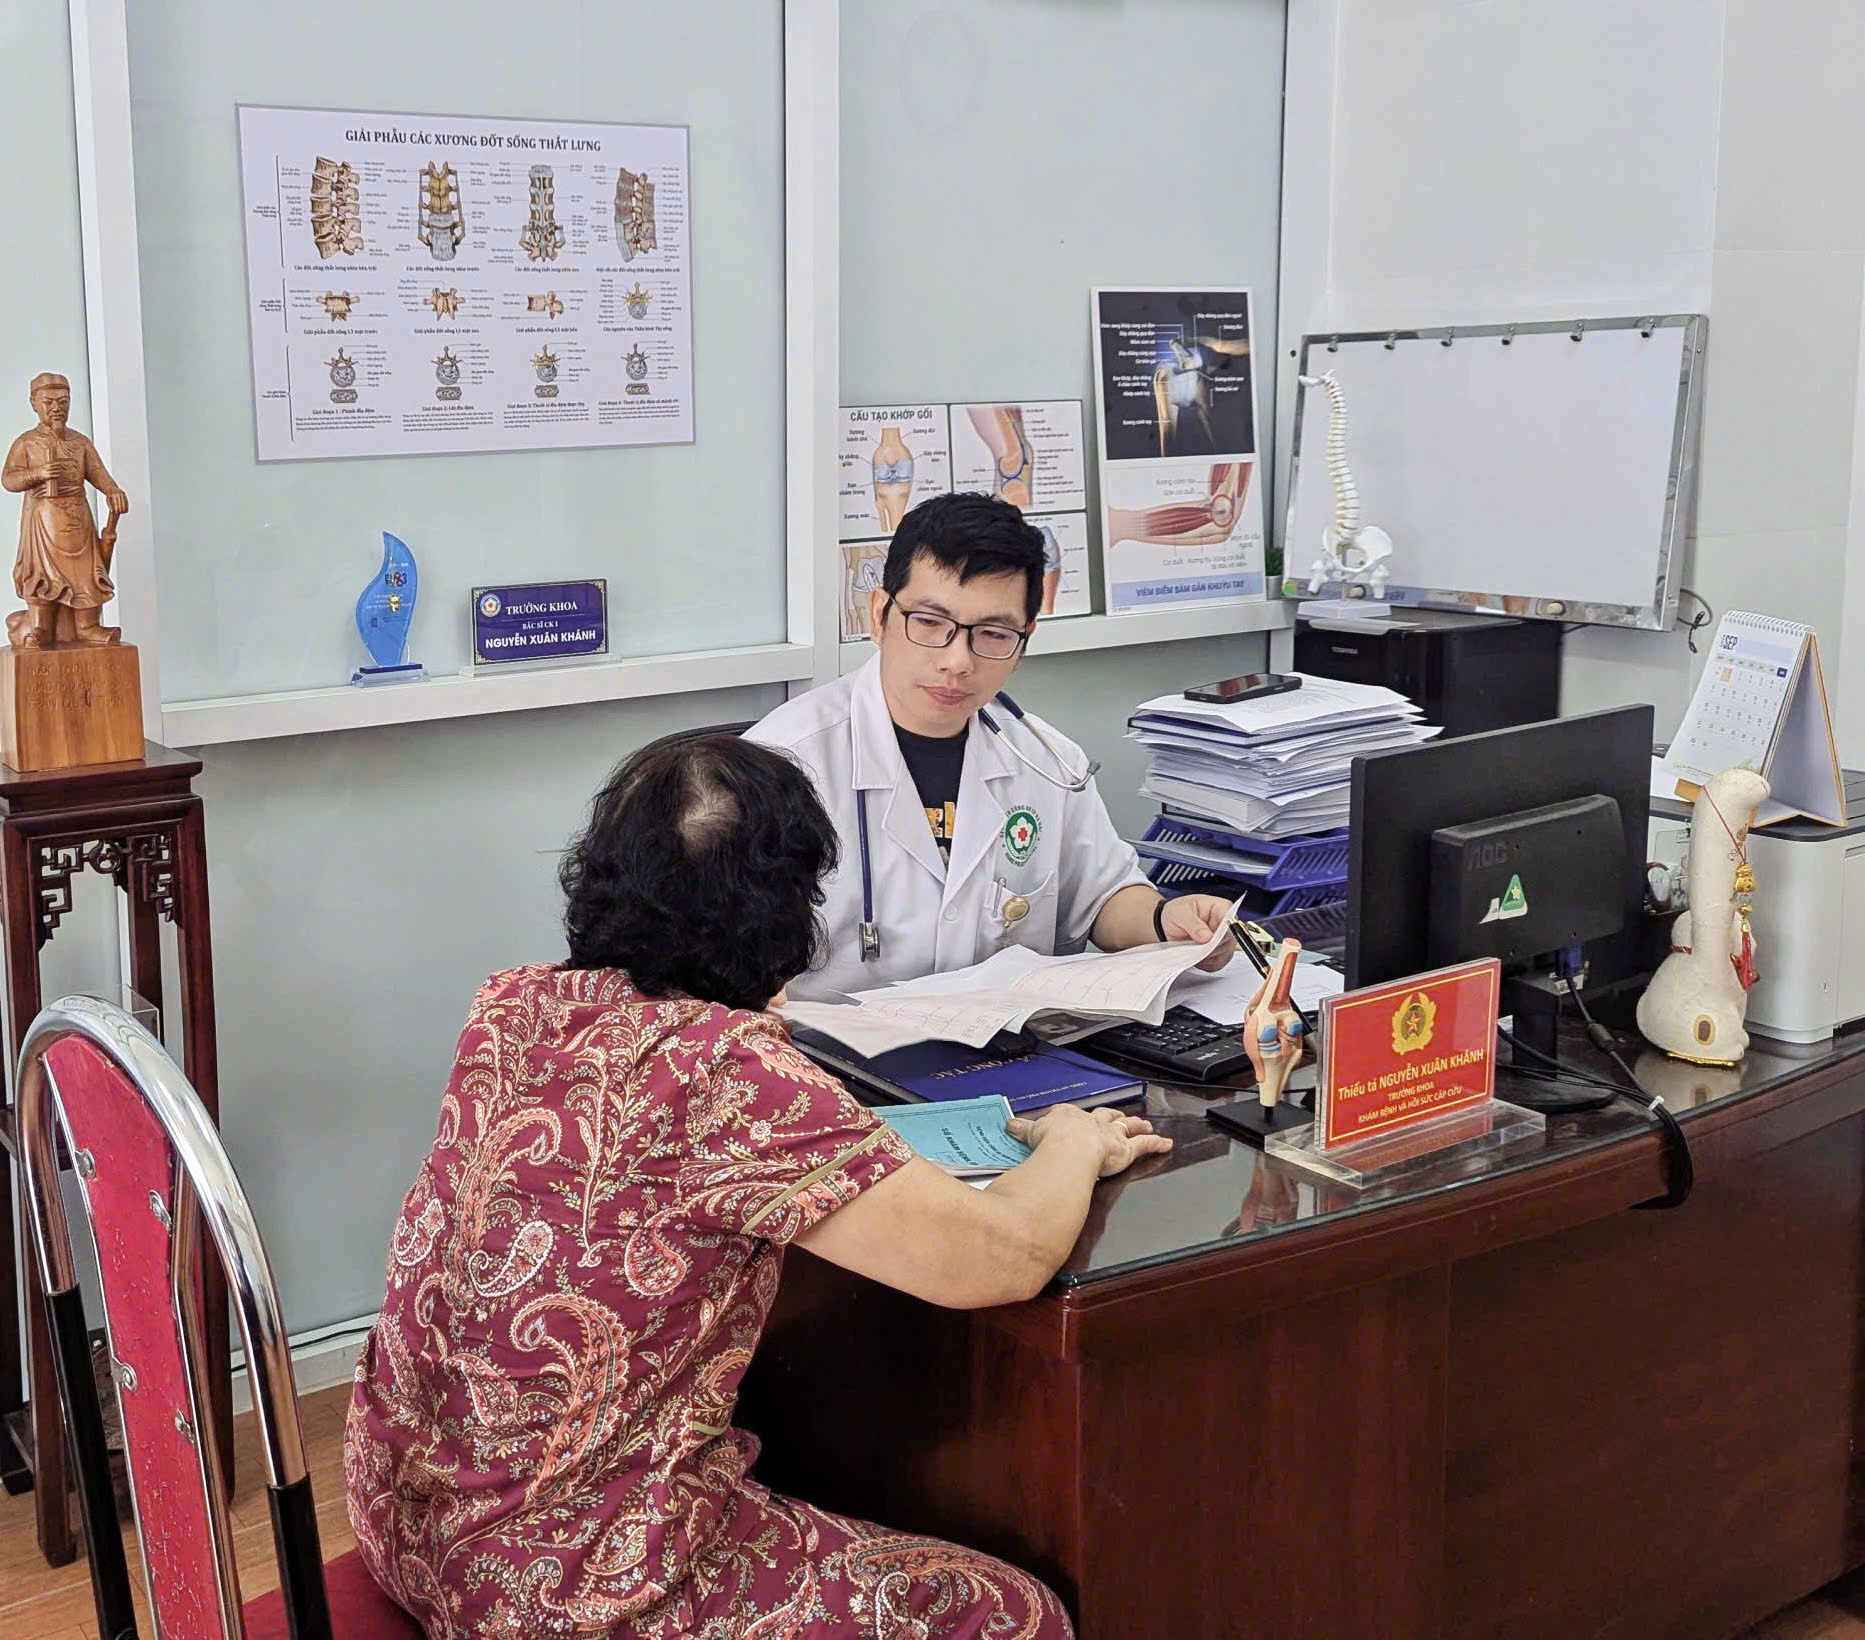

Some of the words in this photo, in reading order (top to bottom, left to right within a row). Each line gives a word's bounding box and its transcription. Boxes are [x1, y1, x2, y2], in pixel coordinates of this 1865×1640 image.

[346, 128, 371, 142] GIẢI
[374, 128, 407, 144] PHẪU
[410, 130, 432, 145] CÁC
[434, 134, 477, 147] XƯƠNG
[481, 132, 504, 148] ĐỐT
[507, 132, 536, 149] SỐNG
[539, 137, 569, 151] THẮT
[571, 138, 601, 151] LƯNG
[850, 410, 869, 422] CẤU
[871, 411, 887, 423] TẠO
[890, 409, 915, 420] KHỚP
[917, 408, 932, 419] GỐI
[1136, 588, 1154, 596] VIÊM
[1155, 584, 1173, 595] ĐIỂM
[1174, 584, 1191, 593] BÁM
[1192, 583, 1206, 591] GÂN
[1232, 580, 1244, 588] TAY
[506, 602, 546, 615] TRƯỞNG
[550, 602, 577, 613] KHOA
[522, 622, 536, 630] BÁC
[485, 632, 526, 649] NGUYỄN
[529, 631, 558, 645] XUÂN
[561, 629, 596, 642] KHÁNH
[1725, 635, 1738, 650] SEP
[1338, 1083, 1364, 1100] Thiếu
[1379, 1063, 1418, 1088] NGUYỄN
[1421, 1057, 1448, 1076] XUÂN
[1450, 1049, 1483, 1070] KHÁNH
[1388, 1087, 1415, 1102] TRƯỞNG
[1416, 1081, 1434, 1094] KHOA
[1358, 1109, 1379, 1123] KHÁM
[1380, 1103, 1397, 1119] BỆNH
[1398, 1099, 1407, 1111] VÀ
[1408, 1096, 1419, 1109] HỒI
[1420, 1093, 1433, 1106] SỨC
[1434, 1090, 1447, 1103] CẤP
[1448, 1085, 1462, 1098] CỨU
